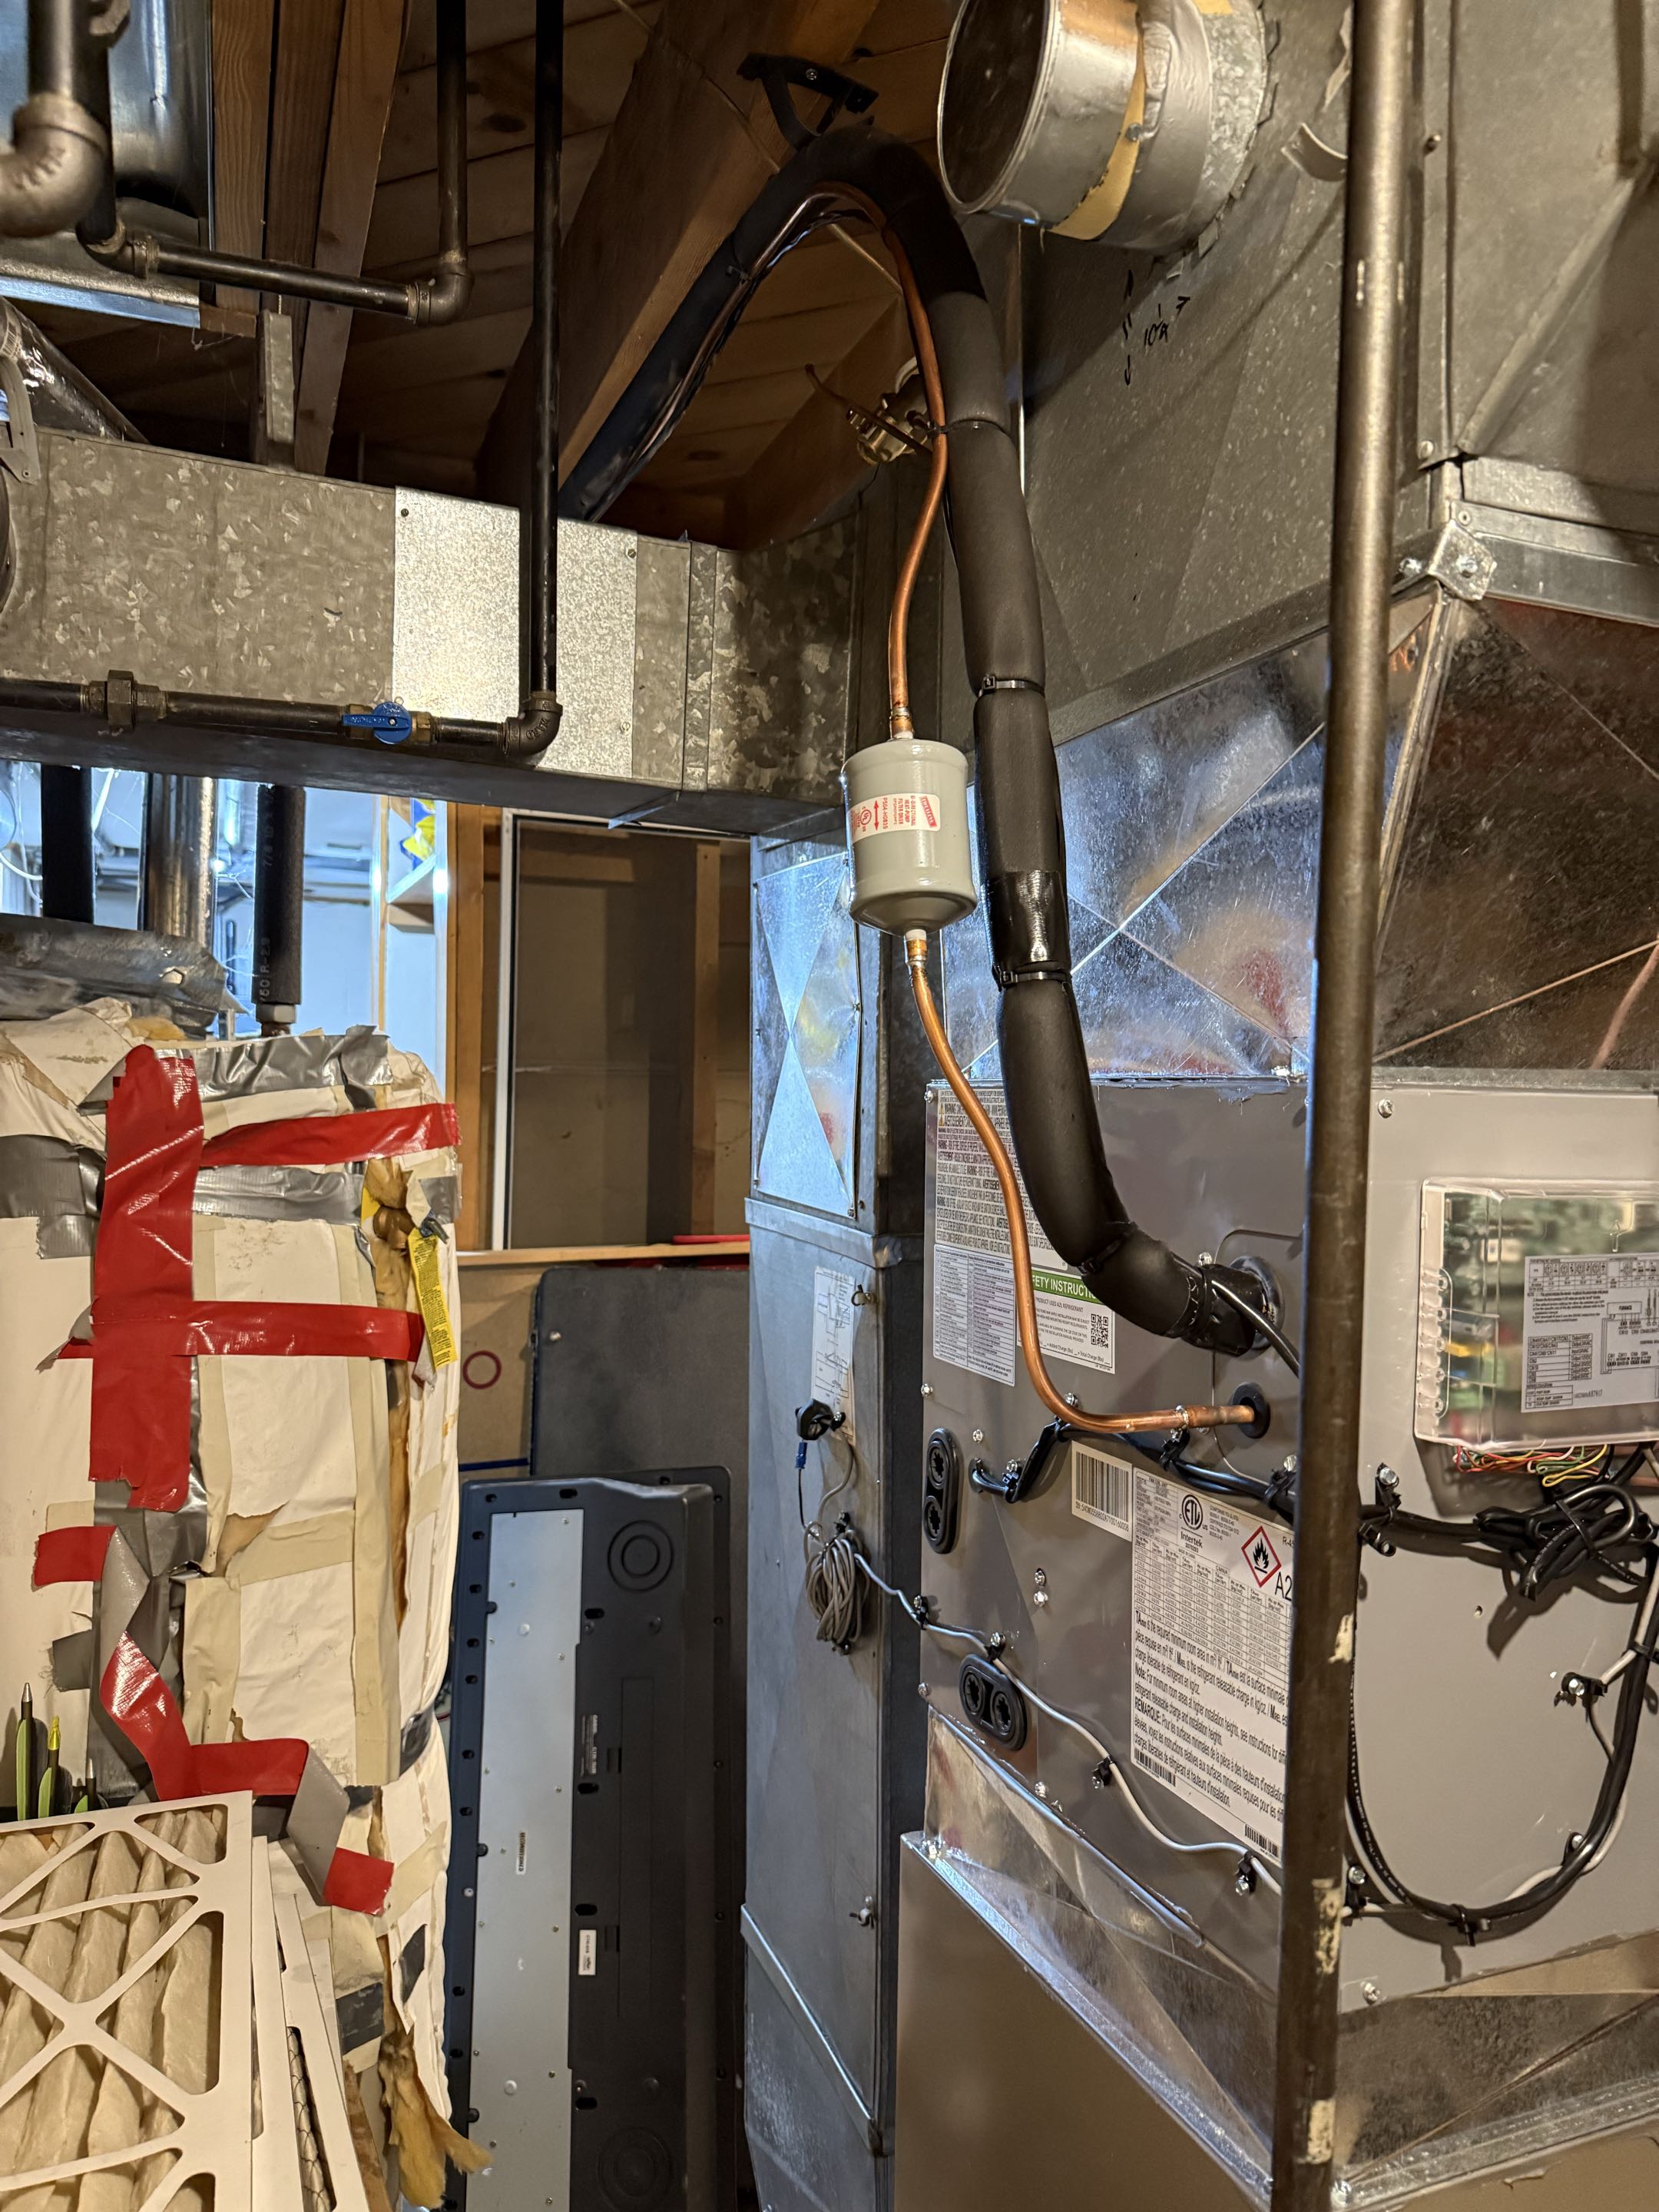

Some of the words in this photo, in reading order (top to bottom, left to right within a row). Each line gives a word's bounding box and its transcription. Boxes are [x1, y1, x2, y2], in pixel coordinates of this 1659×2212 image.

[1180, 1530, 1203, 1548] Intertek
[1134, 1644, 1146, 1667] charge
[1144, 1632, 1157, 1655] requise
[1196, 1662, 1215, 1689] refrigerant
[1215, 1673, 1235, 1697] releasable
[1235, 1684, 1250, 1709] charge
[1156, 1621, 1170, 1645] required
[1170, 1629, 1187, 1651] minimum
[1187, 1641, 1196, 1656] room
[1196, 1646, 1205, 1661] area
[1250, 1673, 1266, 1694] surface
[1266, 1681, 1286, 1705] minimale
[1134, 1679, 1151, 1705] refrigerant
[1151, 1690, 1168, 1712] releasable
[1168, 1700, 1181, 1724] charge
[1188, 1713, 1207, 1737] installation
[1134, 1661, 1146, 1681] Note:
[1152, 1672, 1167, 1694] minimum
[1168, 1684, 1177, 1699] room
[1177, 1690, 1188, 1706] areas
[1192, 1697, 1204, 1720] higher
[1204, 1704, 1224, 1727] installation
[1240, 1728, 1248, 1742] see
[1247, 1730, 1271, 1757] instructions
[1134, 1697, 1161, 1725] REMARQUE:
[1161, 1714, 1170, 1730] Pour
[1176, 1723, 1191, 1744] surfaces
[1191, 1733, 1210, 1756] minimales
[1233, 1760, 1242, 1777] des
[1242, 1764, 1260, 1788] hauteurs
[1134, 1730, 1147, 1754] charges
[1190, 1768, 1206, 1790] hauteurs
[1147, 1725, 1158, 1744] voyez
[1164, 1733, 1184, 1757] instructions
[1183, 1746, 1198, 1767] relatives
[1206, 1760, 1222, 1783] surfaces
[1222, 1771, 1242, 1796] minimales
[1241, 1784, 1260, 1811] requises
[1259, 1798, 1269, 1818] pour
